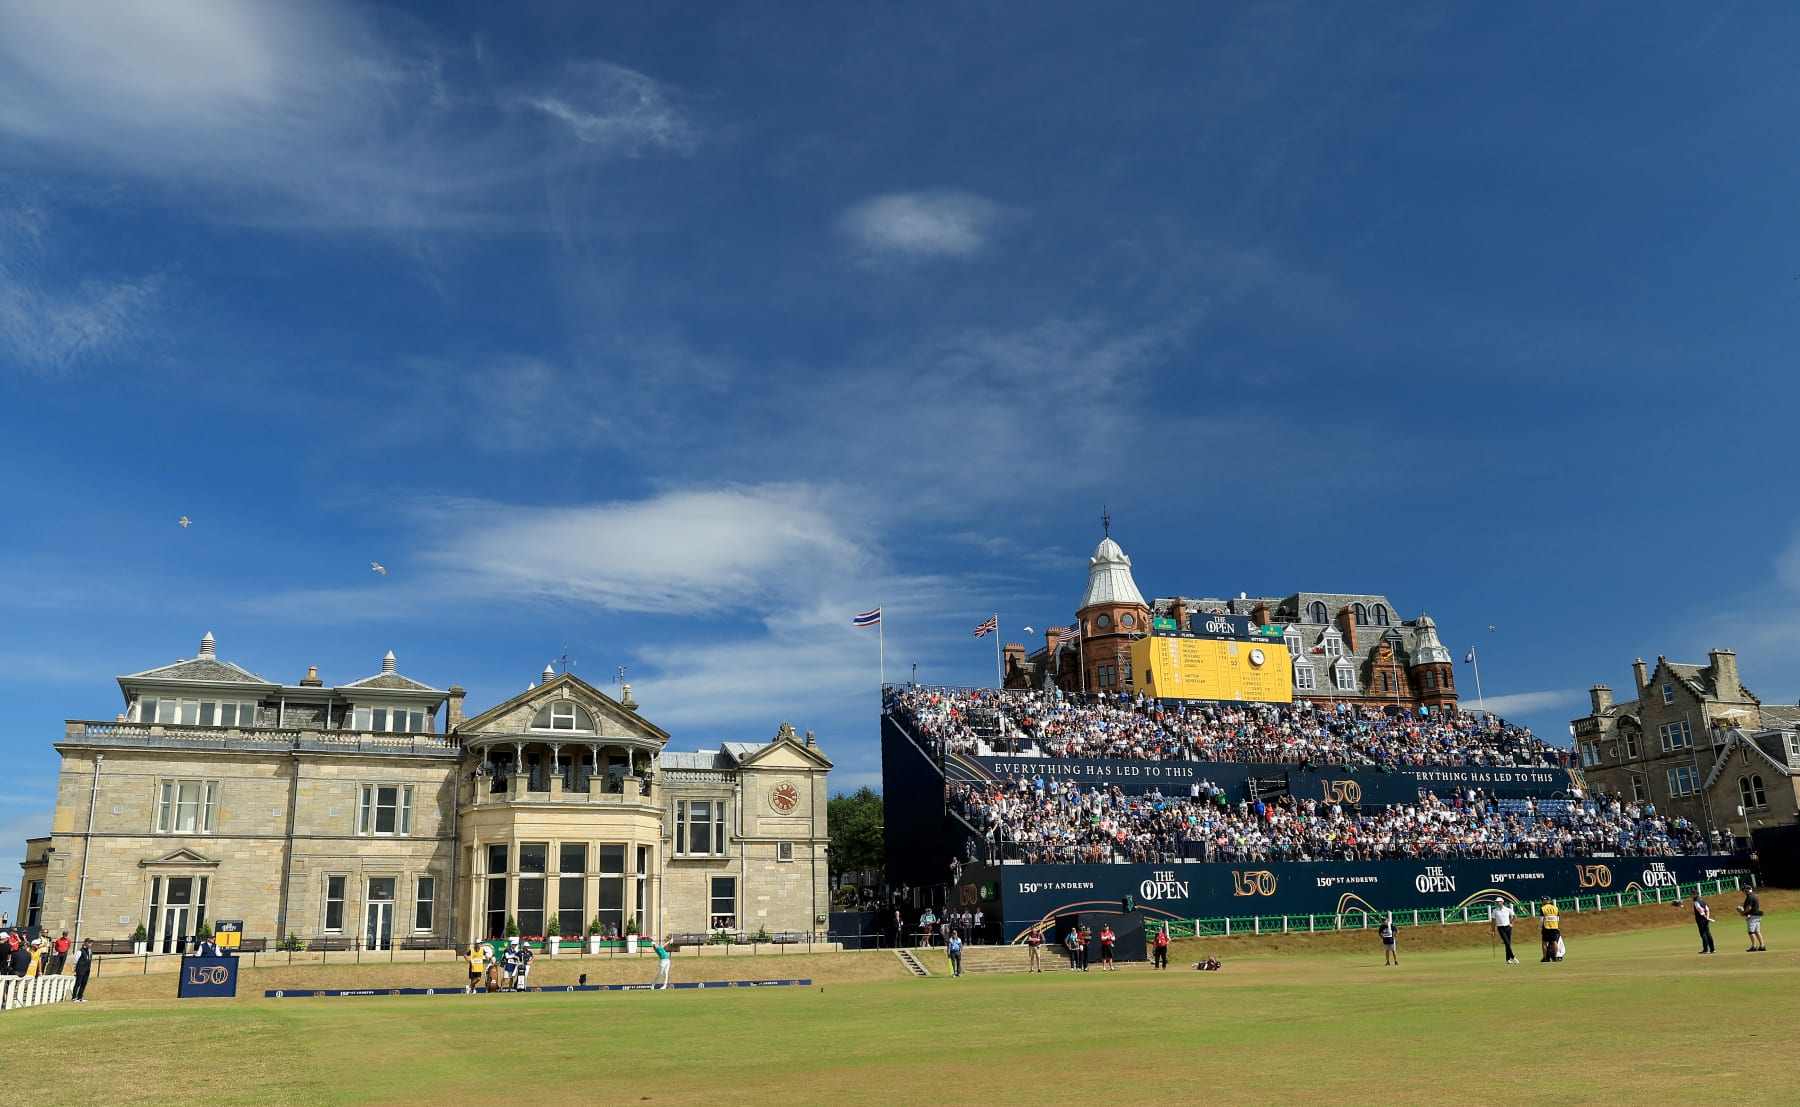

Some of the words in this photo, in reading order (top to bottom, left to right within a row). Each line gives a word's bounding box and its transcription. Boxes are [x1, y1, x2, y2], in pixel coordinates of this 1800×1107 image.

[1206, 621, 1235, 634] OPEN
[994, 763, 1081, 775] EVERYTHING
[1086, 765, 1112, 775] HAS
[1116, 766, 1139, 776] LED
[1144, 767, 1160, 776] TO
[1165, 767, 1193, 777] THIS
[1402, 771, 1468, 781] ERYTHING
[1471, 772, 1491, 781] HAS
[1494, 773, 1512, 782] LED
[1515, 773, 1528, 782] TO
[1531, 773, 1553, 782] THIS
[1320, 779, 1362, 803] 150
[1425, 866, 1444, 877] THE
[1650, 862, 1666, 872] THE
[1153, 871, 1175, 881] THE
[1517, 872, 1544, 880] ANDREWS
[1576, 864, 1612, 888] 150
[1642, 869, 1677, 887] OPEN
[1043, 882, 1053, 890] ST
[1140, 879, 1189, 900] OPEN
[1231, 870, 1277, 897] 150
[1415, 874, 1456, 893] OPEN
[187, 966, 229, 985] 150
